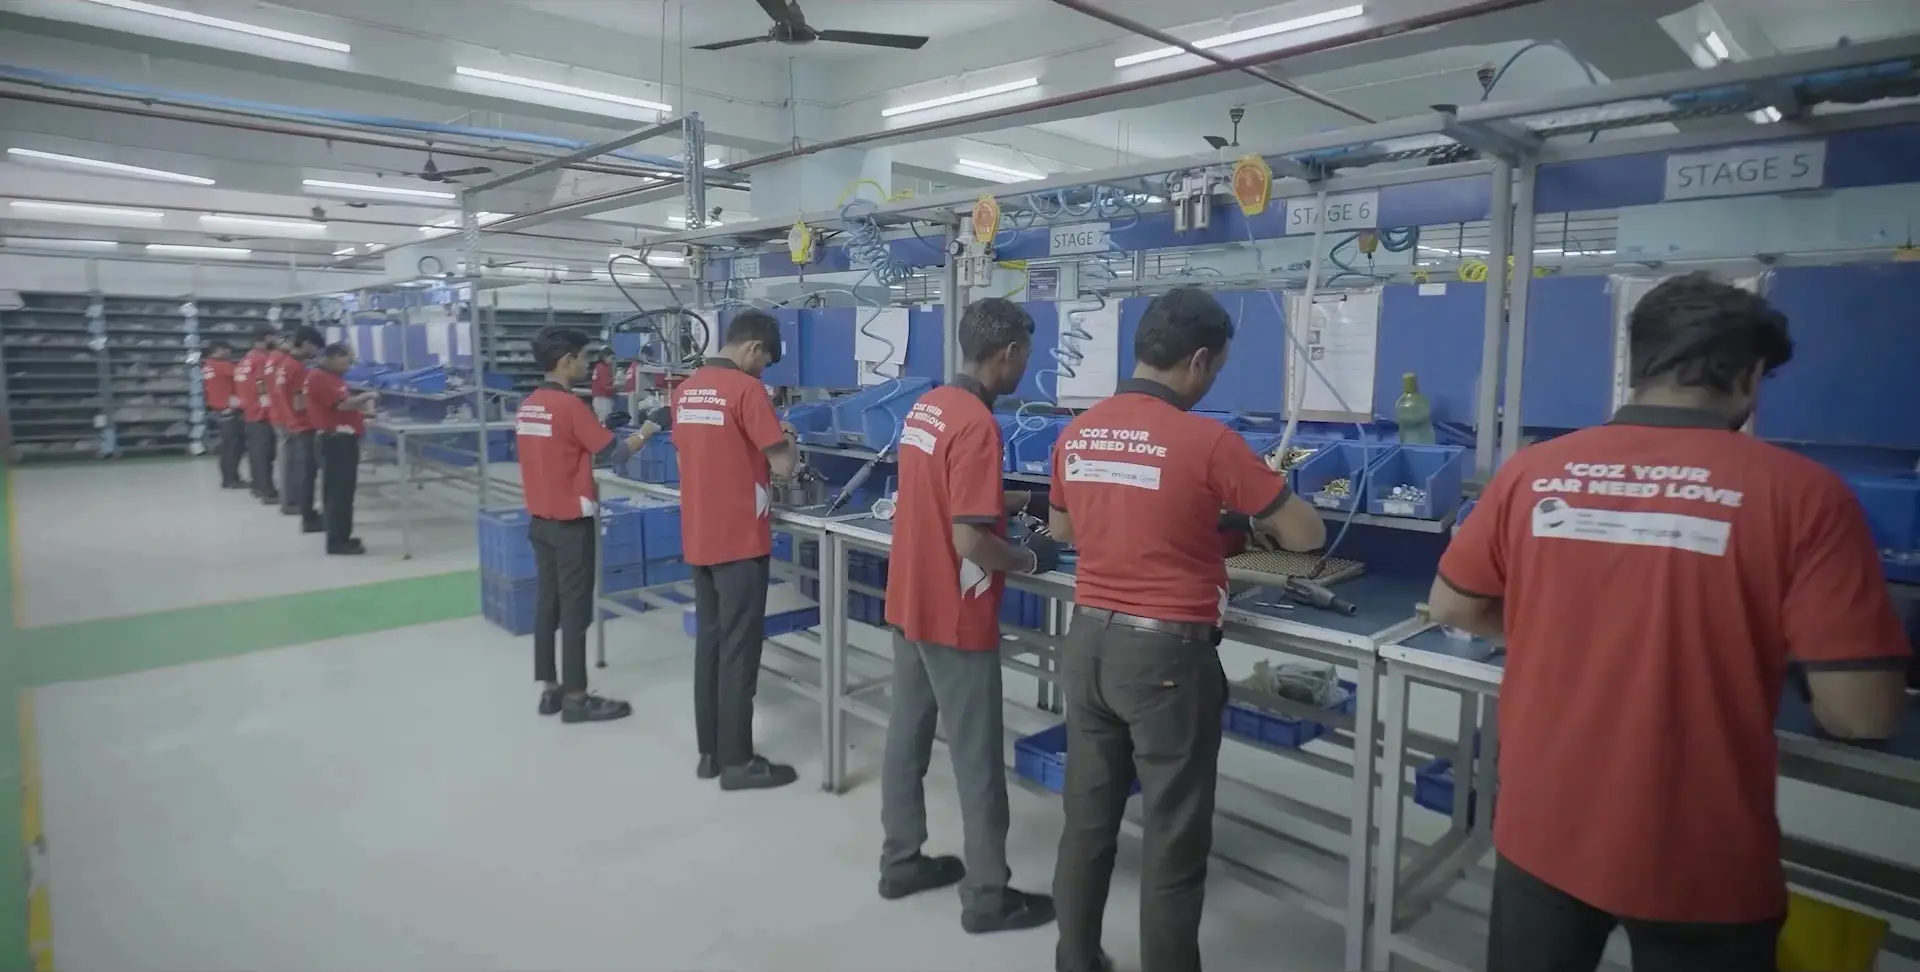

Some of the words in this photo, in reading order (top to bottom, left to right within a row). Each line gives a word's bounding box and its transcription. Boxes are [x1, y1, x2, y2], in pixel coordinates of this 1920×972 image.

[1677, 156, 1780, 188] STAGE
[1790, 153, 1811, 178] 5
[1292, 203, 1353, 225] STGE
[1359, 201, 1370, 219] 6
[1053, 231, 1094, 248] STAGE
[1111, 429, 1150, 442] YOUR
[1065, 439, 1087, 450] CAR
[1090, 440, 1125, 451] NEED
[1128, 442, 1168, 457] LOVE
[1632, 465, 1711, 482] YOUR
[1532, 478, 1582, 493] CAR
[1588, 480, 1660, 498] NEED
[1665, 483, 1744, 507] LOVE
